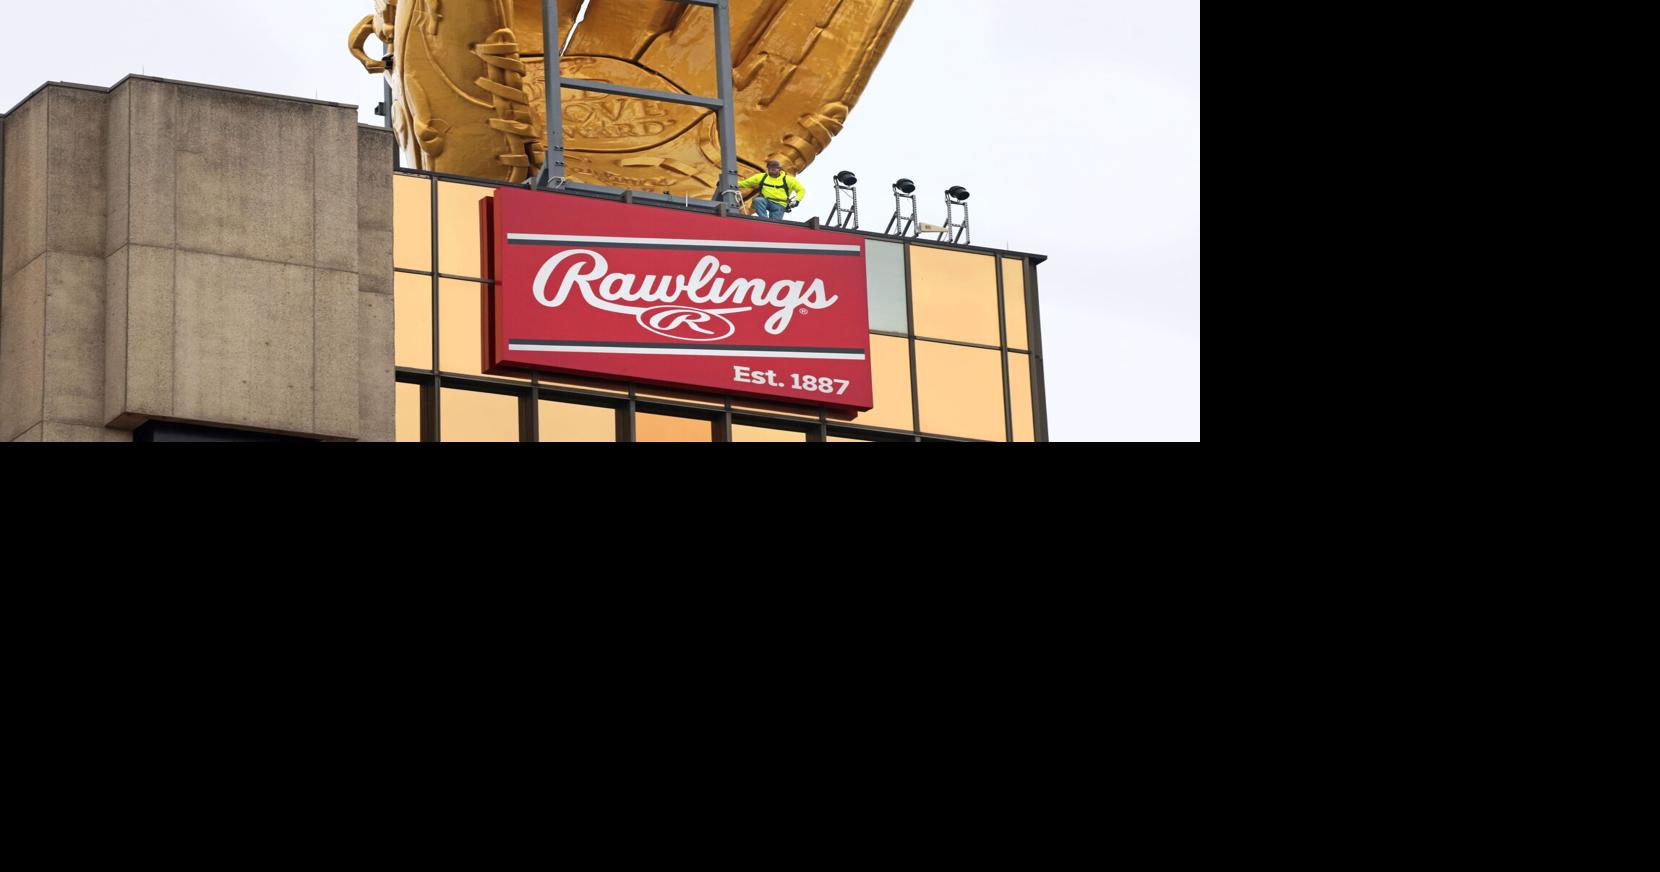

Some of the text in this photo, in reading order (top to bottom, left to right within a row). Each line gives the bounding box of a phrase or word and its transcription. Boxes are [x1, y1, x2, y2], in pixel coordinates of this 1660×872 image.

[532, 248, 839, 336] Rawlings
[733, 365, 851, 395] Est. 1887
